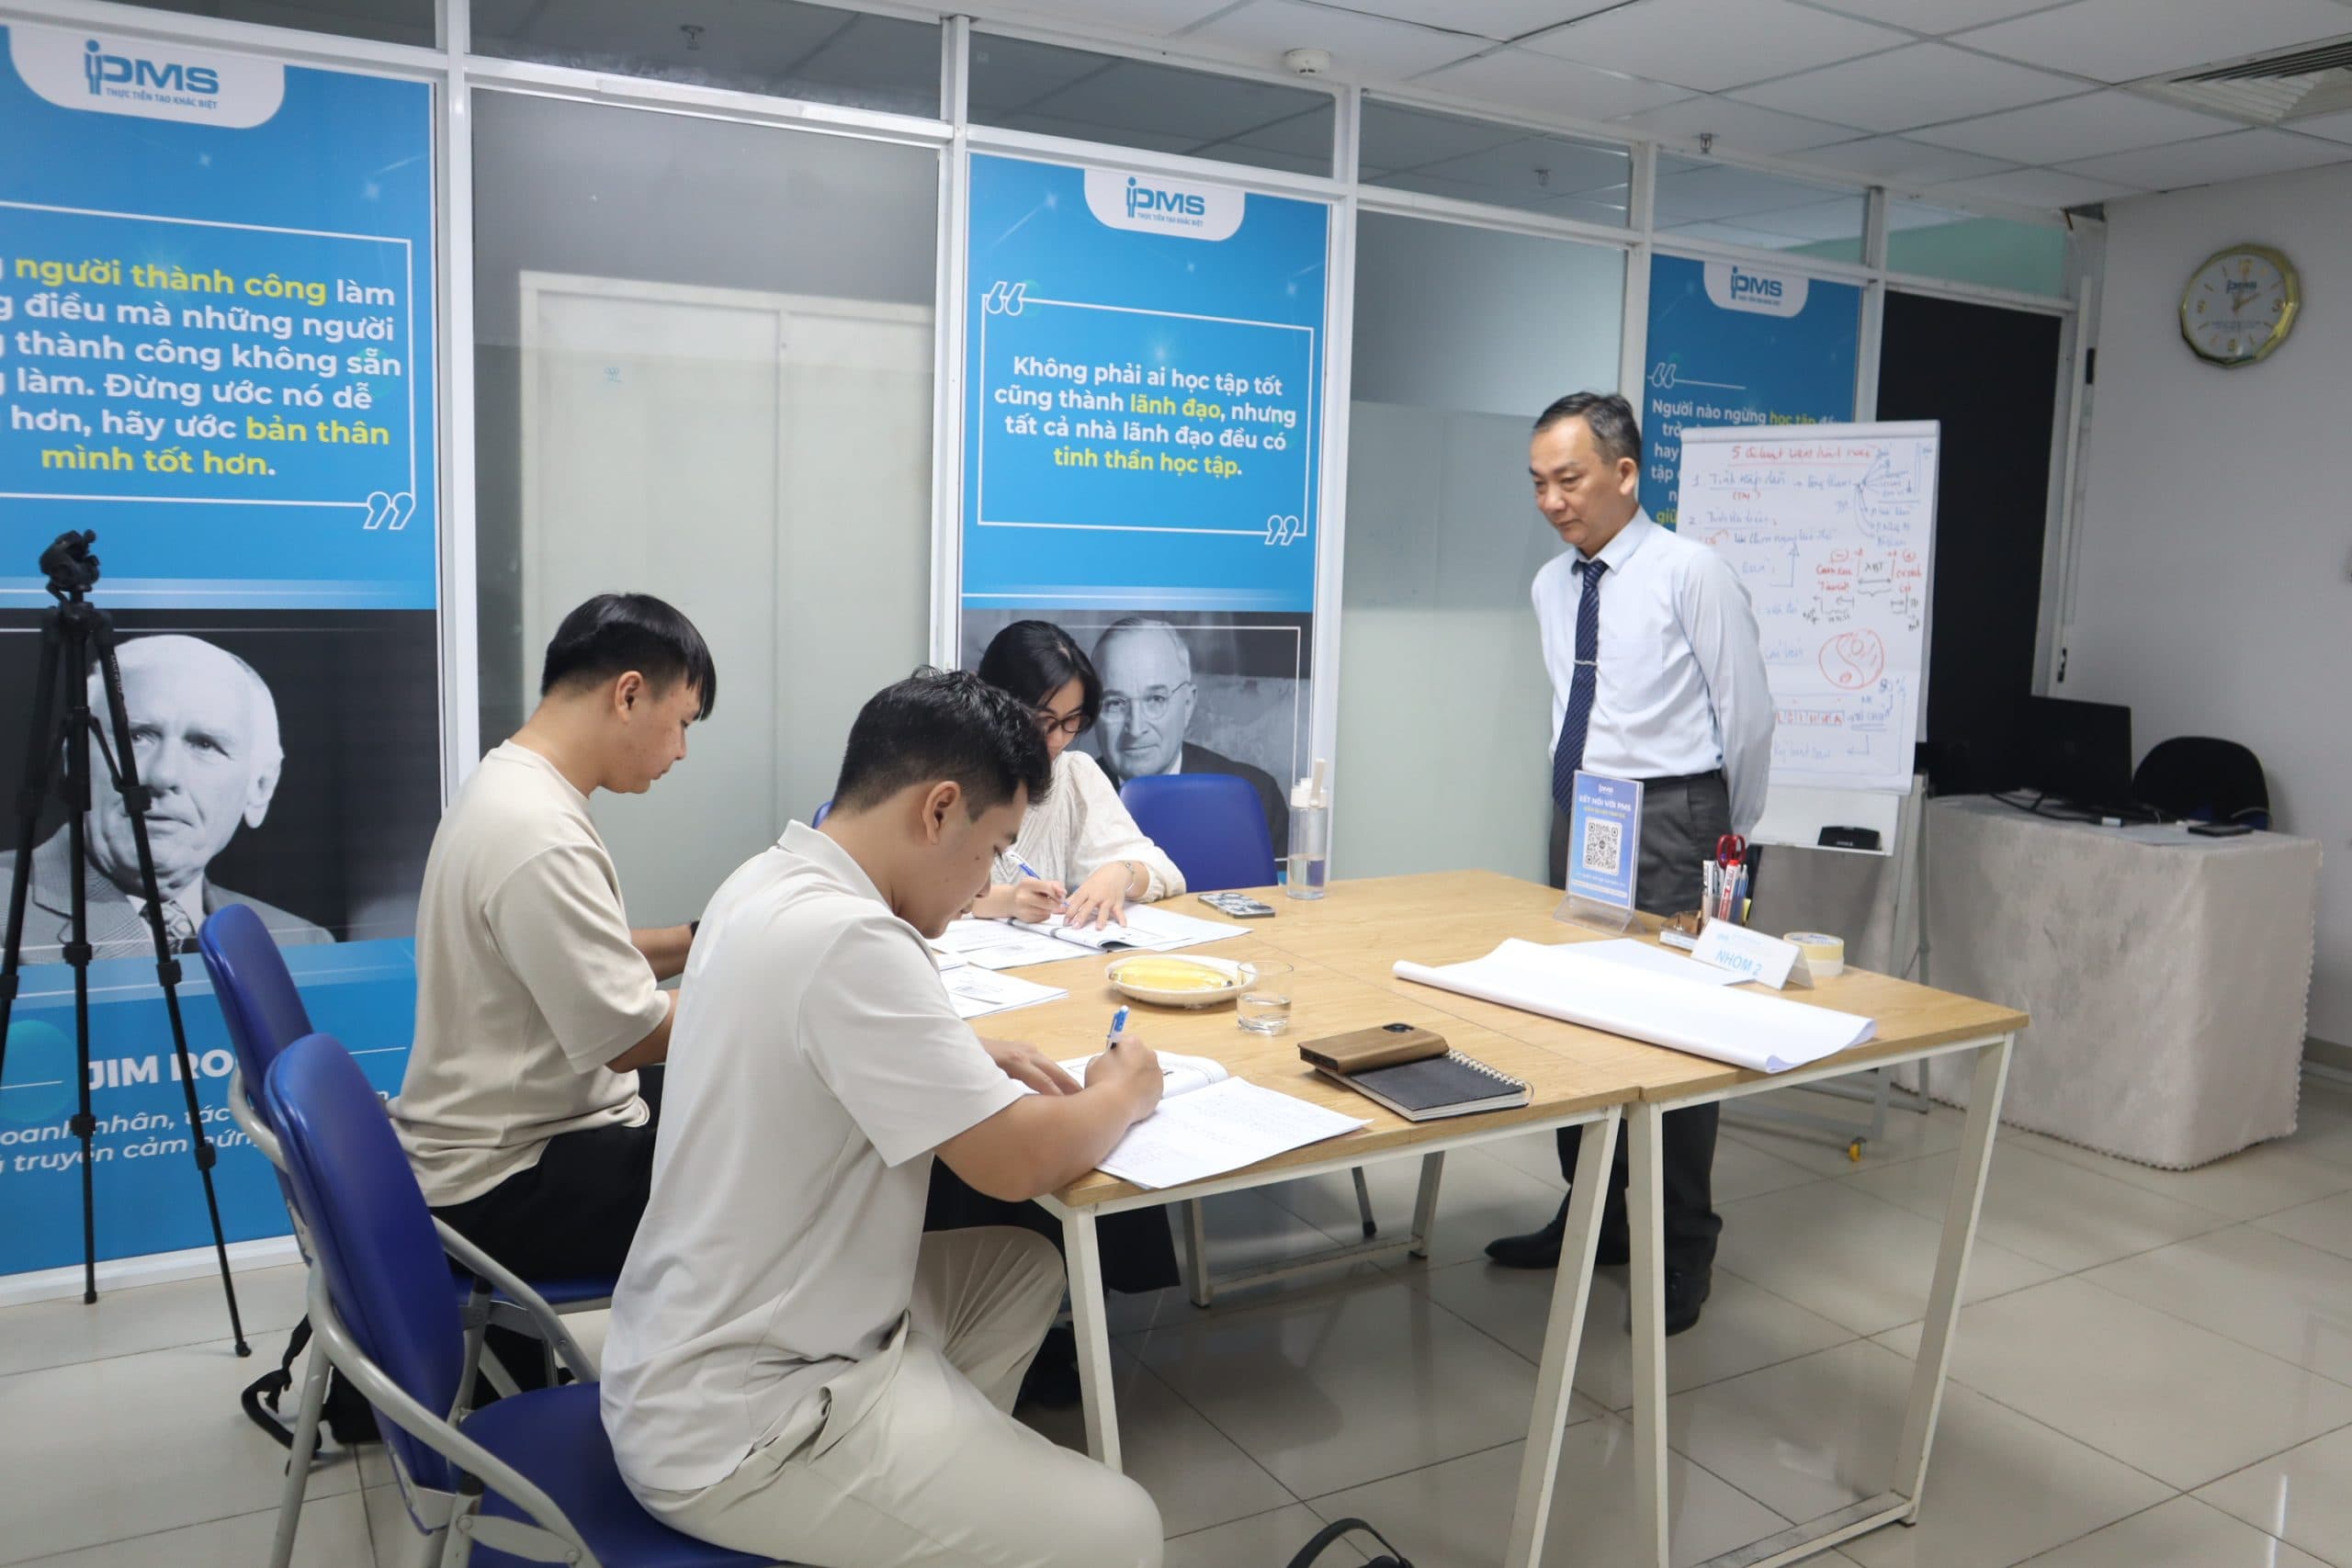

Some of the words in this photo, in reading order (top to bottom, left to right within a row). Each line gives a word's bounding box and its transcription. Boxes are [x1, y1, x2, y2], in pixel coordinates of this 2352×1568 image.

[14, 258, 122, 287] người
[130, 263, 234, 294] thành
[243, 273, 327, 307] công
[336, 278, 395, 306] làm
[24, 292, 106, 322] điều
[116, 300, 172, 327] mà
[182, 305, 293, 340] những
[302, 316, 395, 344] người
[15, 330, 126, 361] thành
[134, 338, 221, 372] công
[232, 343, 337, 378] không
[346, 347, 401, 377] sẵn
[17, 367, 96, 396] làm.
[103, 373, 201, 407] Đừng
[212, 379, 273, 405] ước
[283, 383, 324, 407] nó
[333, 381, 373, 410] dễ
[1013, 355, 1088, 385] Không
[1093, 362, 1141, 386] phải
[1147, 366, 1166, 387] ai
[1171, 367, 1210, 394] học
[1215, 373, 1250, 397] tập
[1253, 375, 1283, 396] tốt
[11, 404, 92, 438] hơn,
[102, 409, 166, 442] hãy
[175, 413, 236, 439] ước
[246, 414, 307, 442] bản
[316, 420, 390, 446] thân
[994, 384, 1053, 412] cũng
[1058, 389, 1125, 412] thành
[1130, 393, 1176, 415] lãnh
[1182, 398, 1226, 423] đạo,
[1231, 401, 1296, 429] nhưng
[1652, 399, 1693, 419] Người
[1696, 404, 1722, 419] nào
[1724, 407, 1767, 425] ngừng
[1004, 412, 1038, 435] tất
[1043, 415, 1069, 437] cả
[1075, 419, 1117, 440] nhà
[1123, 421, 1170, 444] lãnh
[1174, 425, 1215, 450] đạo
[1218, 427, 1258, 449] đều
[1262, 432, 1287, 451] có
[41, 444, 135, 471] mình
[142, 446, 195, 473] tốt
[203, 449, 277, 476] hơn.
[1053, 445, 1099, 468] tinh
[1103, 448, 1154, 470] thần
[1159, 452, 1199, 477] học
[1204, 455, 1243, 479] tập.
[1654, 441, 1680, 463] hay
[1651, 464, 1674, 483] tập
[87, 1055, 159, 1090] JIM
[169, 1049, 234, 1082] RO
[93, 1111, 175, 1135] nhân,
[184, 1103, 231, 1125] tác
[122, 1135, 188, 1159] cảm
